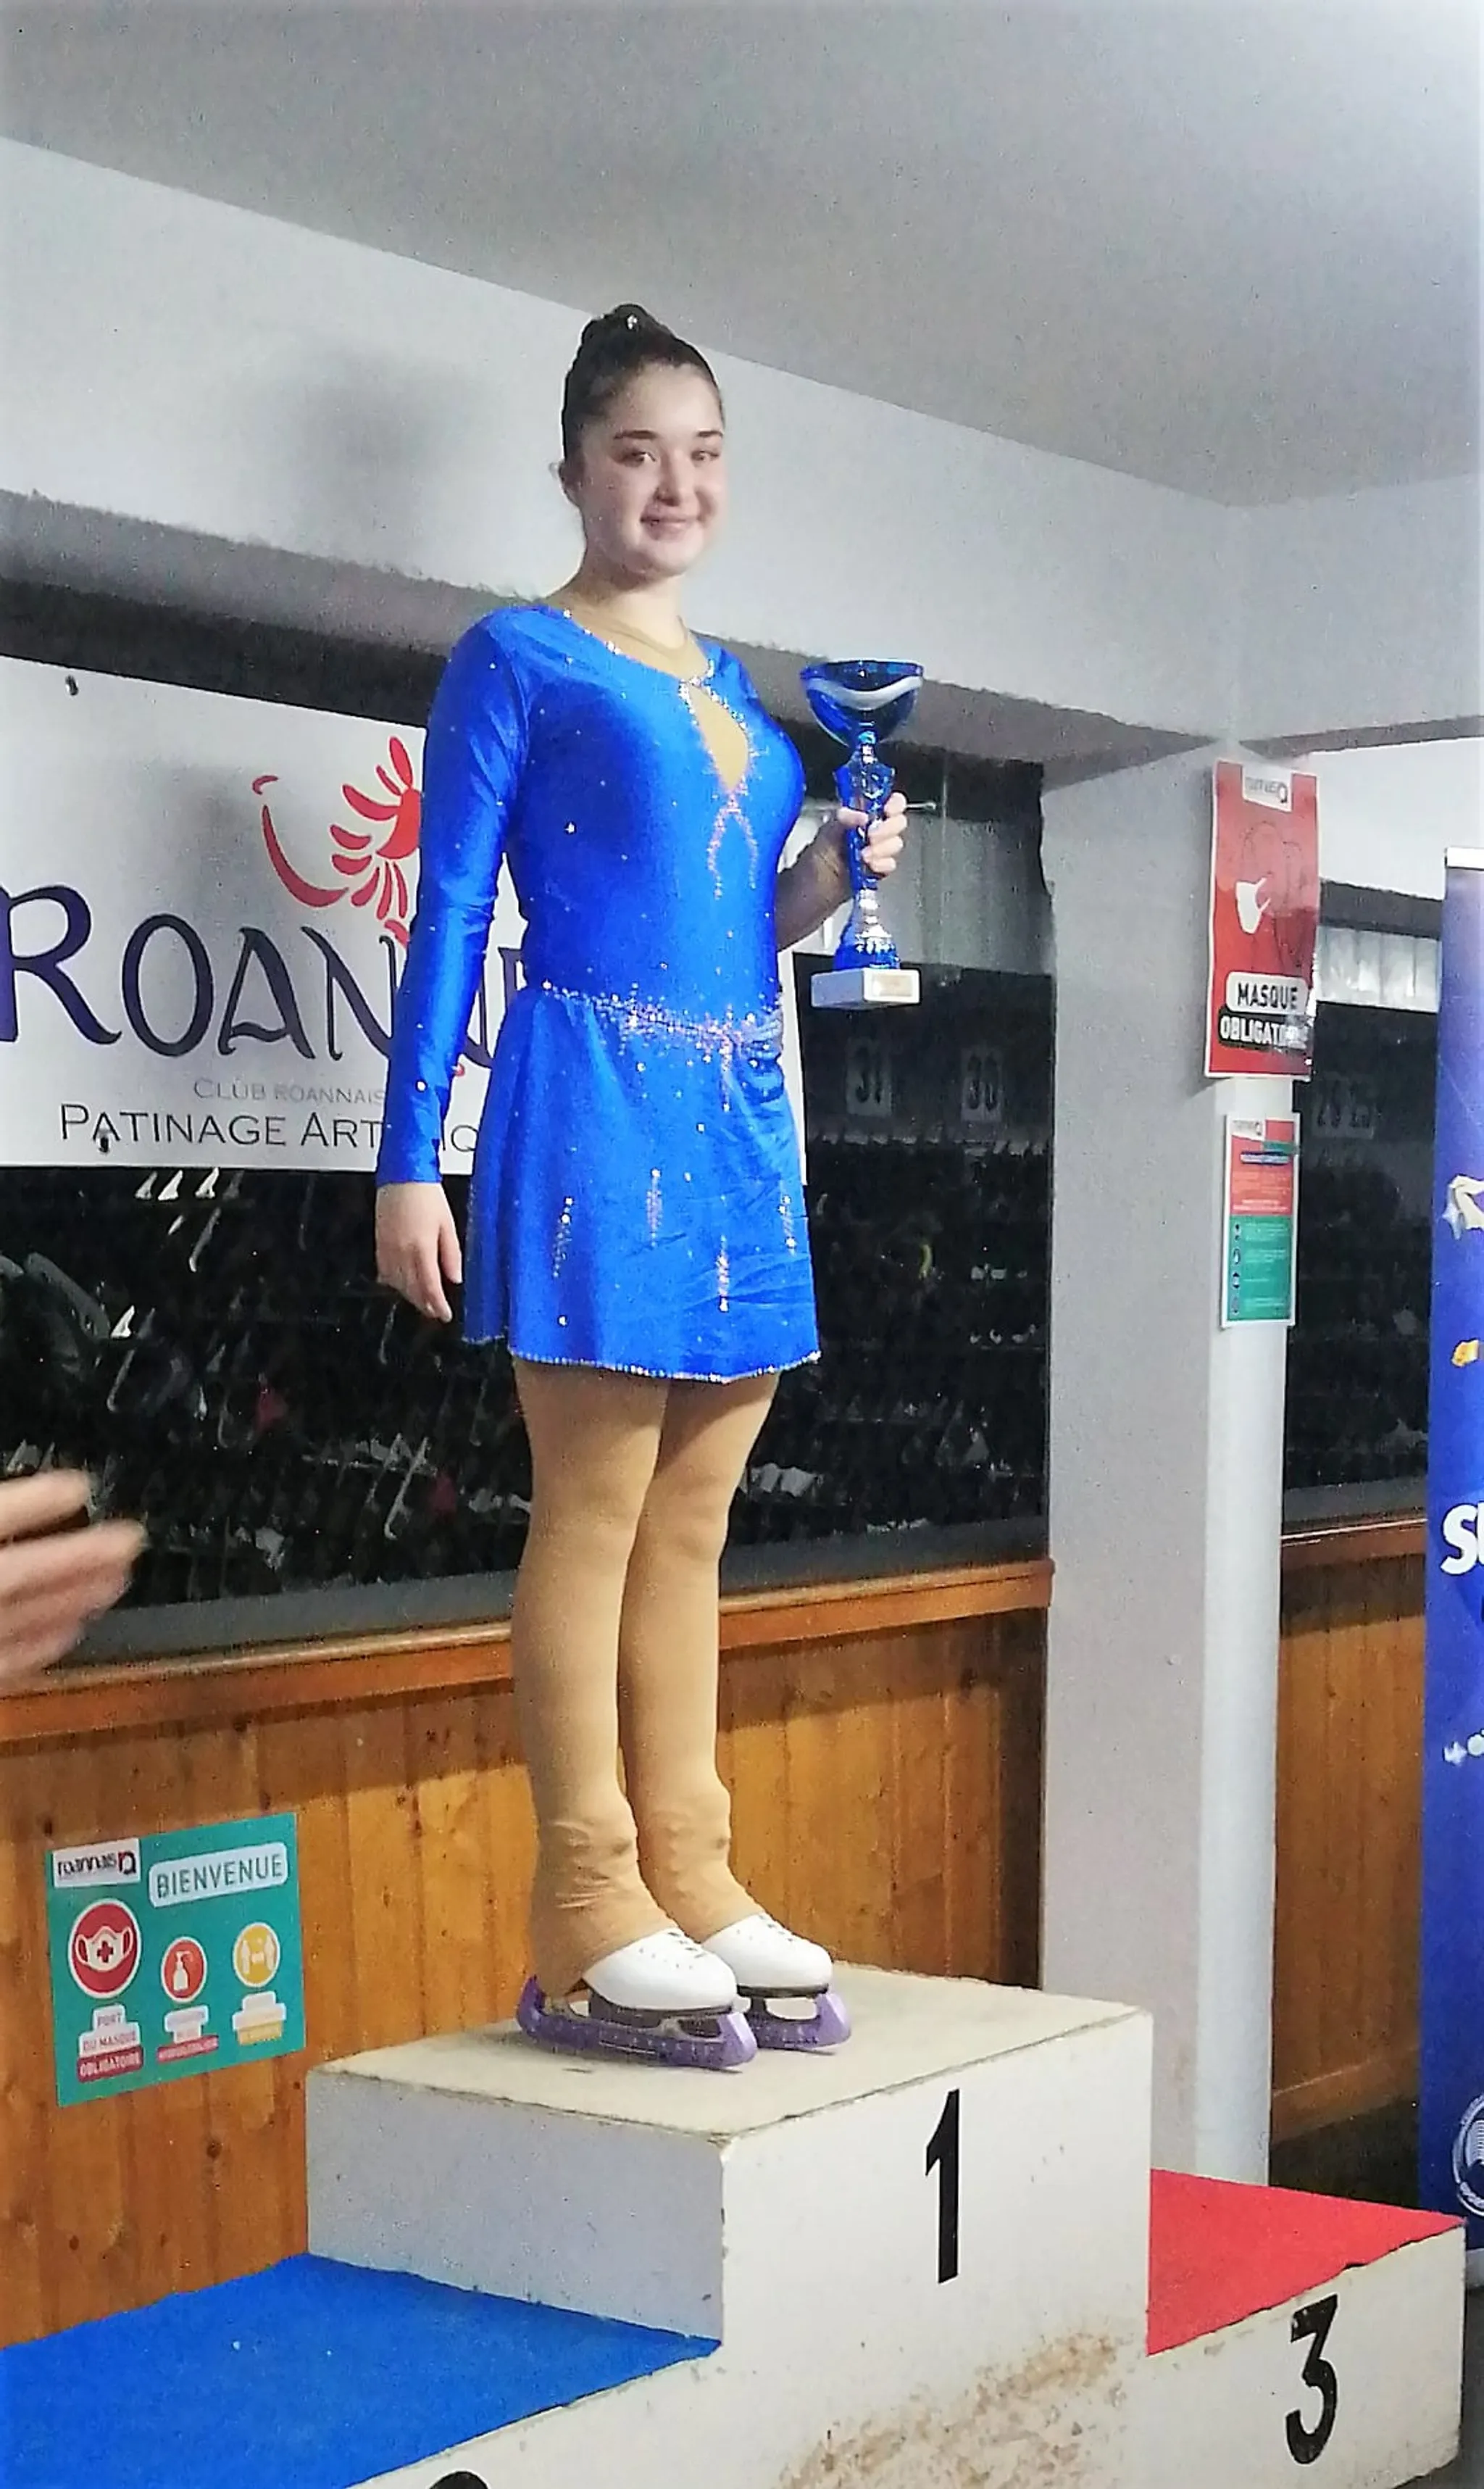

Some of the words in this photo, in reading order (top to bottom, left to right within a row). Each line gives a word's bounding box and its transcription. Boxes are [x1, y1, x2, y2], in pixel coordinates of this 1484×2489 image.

[0, 884, 525, 1069] ROAN
[1237, 981, 1298, 1010] MASQUE
[1219, 1015, 1307, 1050] OBLIGAT
[194, 1078, 265, 1100] CLUB
[62, 1104, 287, 1147] PATINAGE
[157, 1853, 283, 1900] BIENVENUE
[925, 2087, 960, 2284] 1
[1285, 2293, 1339, 2465] 3
